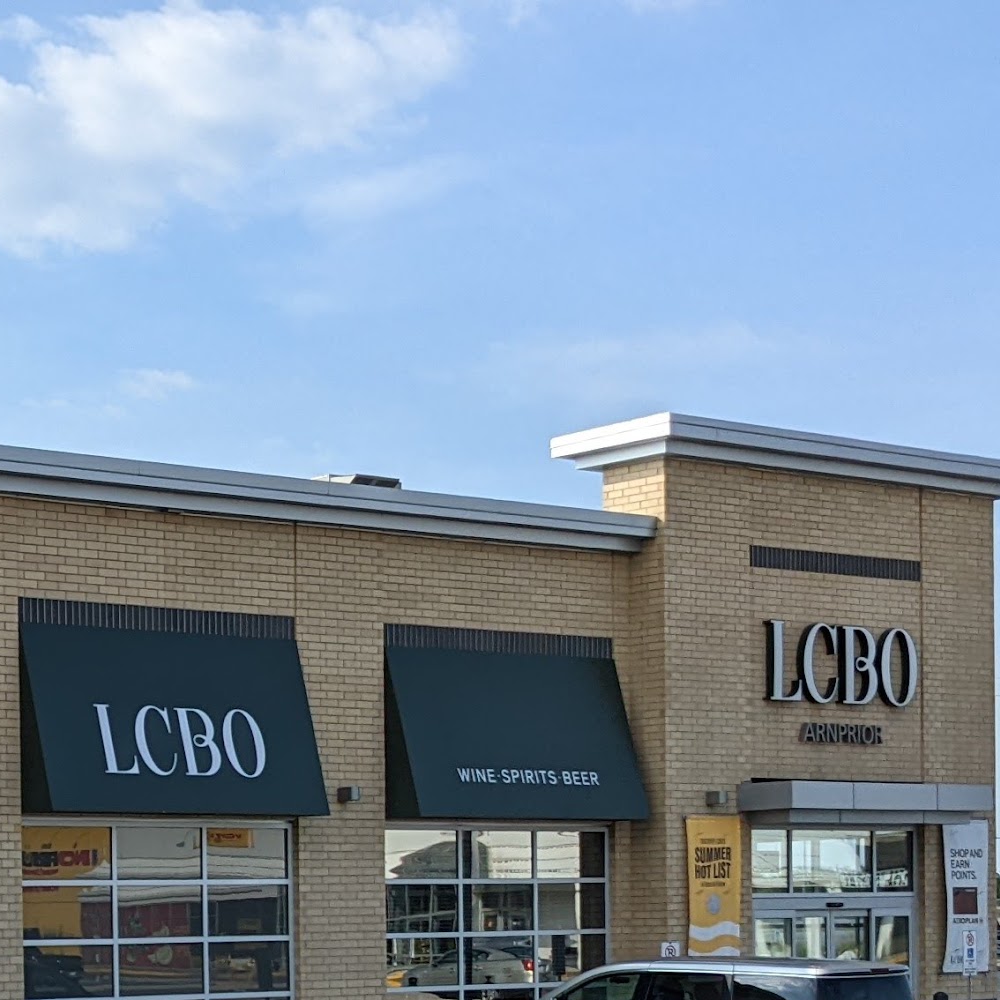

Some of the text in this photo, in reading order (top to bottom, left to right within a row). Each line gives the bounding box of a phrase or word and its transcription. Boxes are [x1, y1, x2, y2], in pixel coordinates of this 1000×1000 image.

[762, 618, 918, 708] LCBO
[93, 702, 266, 778] LCBO
[800, 721, 884, 745] ARNPRIOR
[456, 767, 600, 786] WINE SPIRITS BEER
[694, 846, 731, 864] SUMMER
[950, 848, 983, 858] SHOP AND
[694, 861, 730, 879] HOT LIST
[950, 859, 970, 869] EARN
